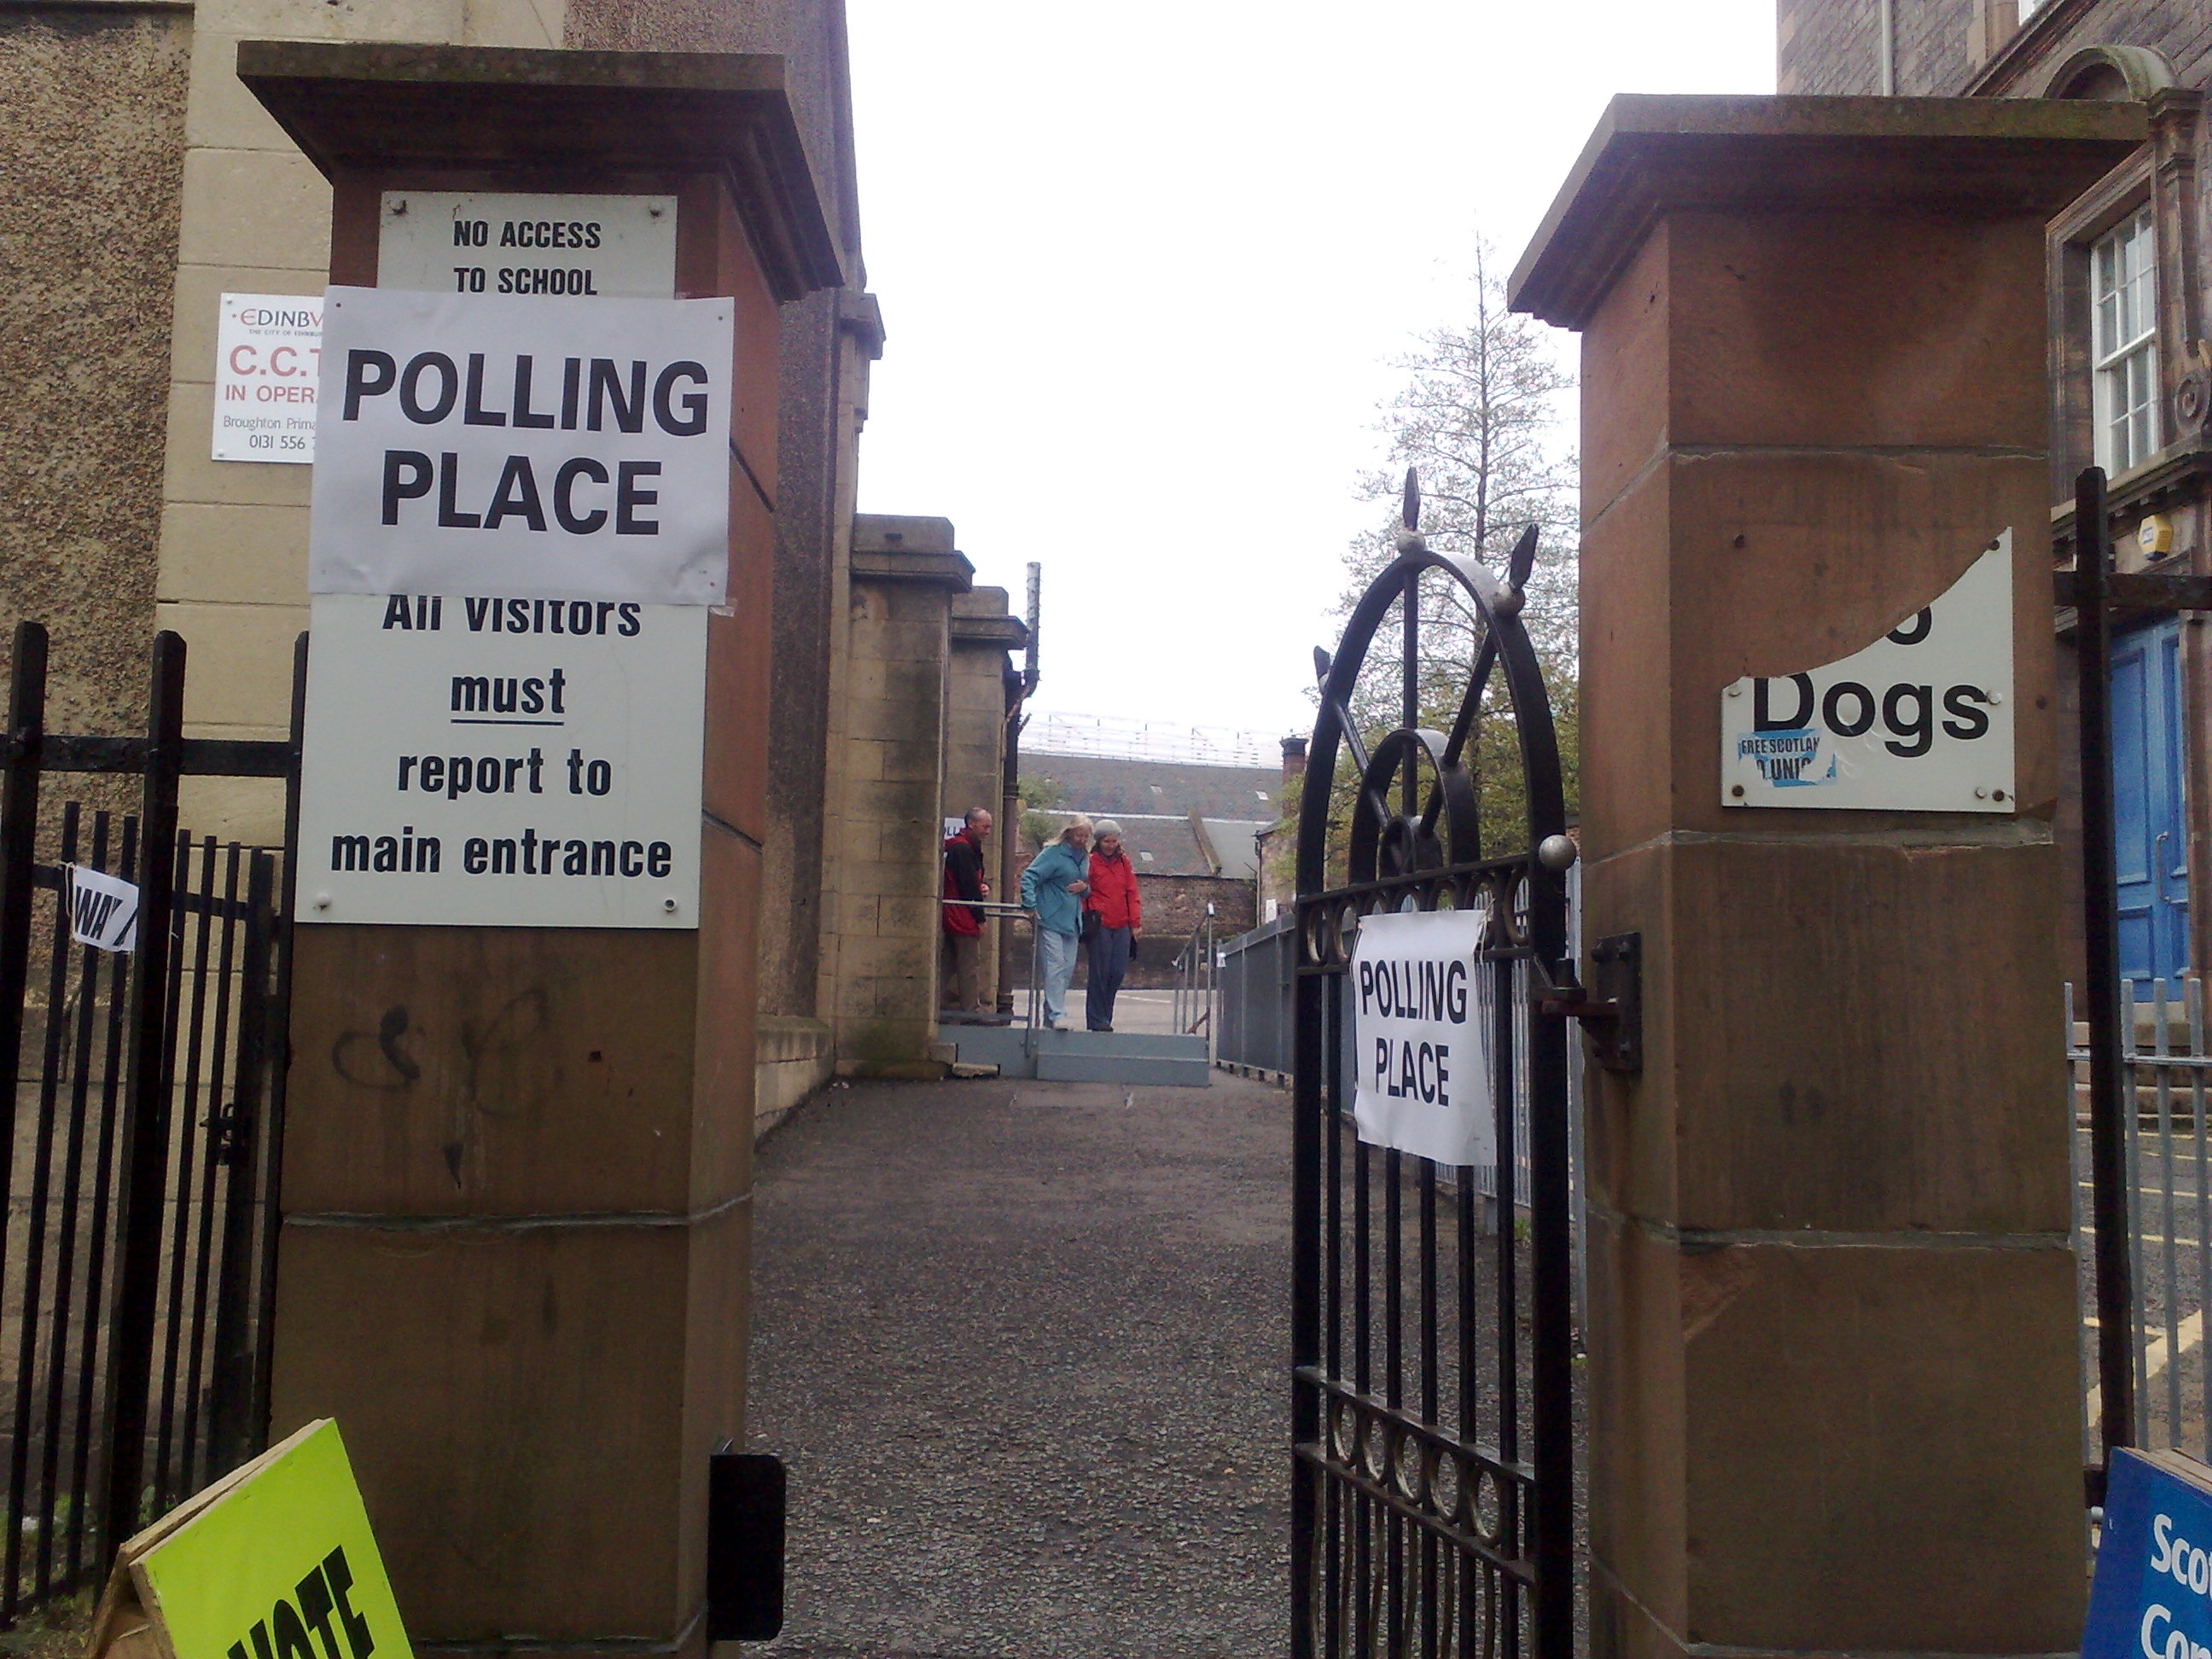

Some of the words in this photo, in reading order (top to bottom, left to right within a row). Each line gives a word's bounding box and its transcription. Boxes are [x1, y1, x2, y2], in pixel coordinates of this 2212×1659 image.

[453, 220, 488, 248] NO
[499, 220, 602, 249] ACCESS
[453, 267, 486, 294] TO
[498, 268, 598, 295] SCHOOL
[225, 384, 247, 401] IN
[256, 385, 317, 404] OPER
[342, 348, 709, 438] POLLING
[223, 416, 281, 431] Broughton
[249, 434, 274, 449] 0131
[280, 435, 306, 451] 556
[381, 450, 662, 536] PLACE
[382, 594, 443, 632] All
[464, 597, 642, 637] visitors
[451, 668, 566, 715] must
[1754, 672, 1990, 758] Dogs
[1741, 739, 1768, 754] FREE
[398, 748, 544, 800] report
[567, 748, 612, 796] to
[331, 826, 442, 874] main
[463, 828, 672, 878] entrance
[1360, 960, 1467, 1024] POLLING
[1376, 1037, 1449, 1107] PLACE
[2151, 1514, 2212, 1600] Sco
